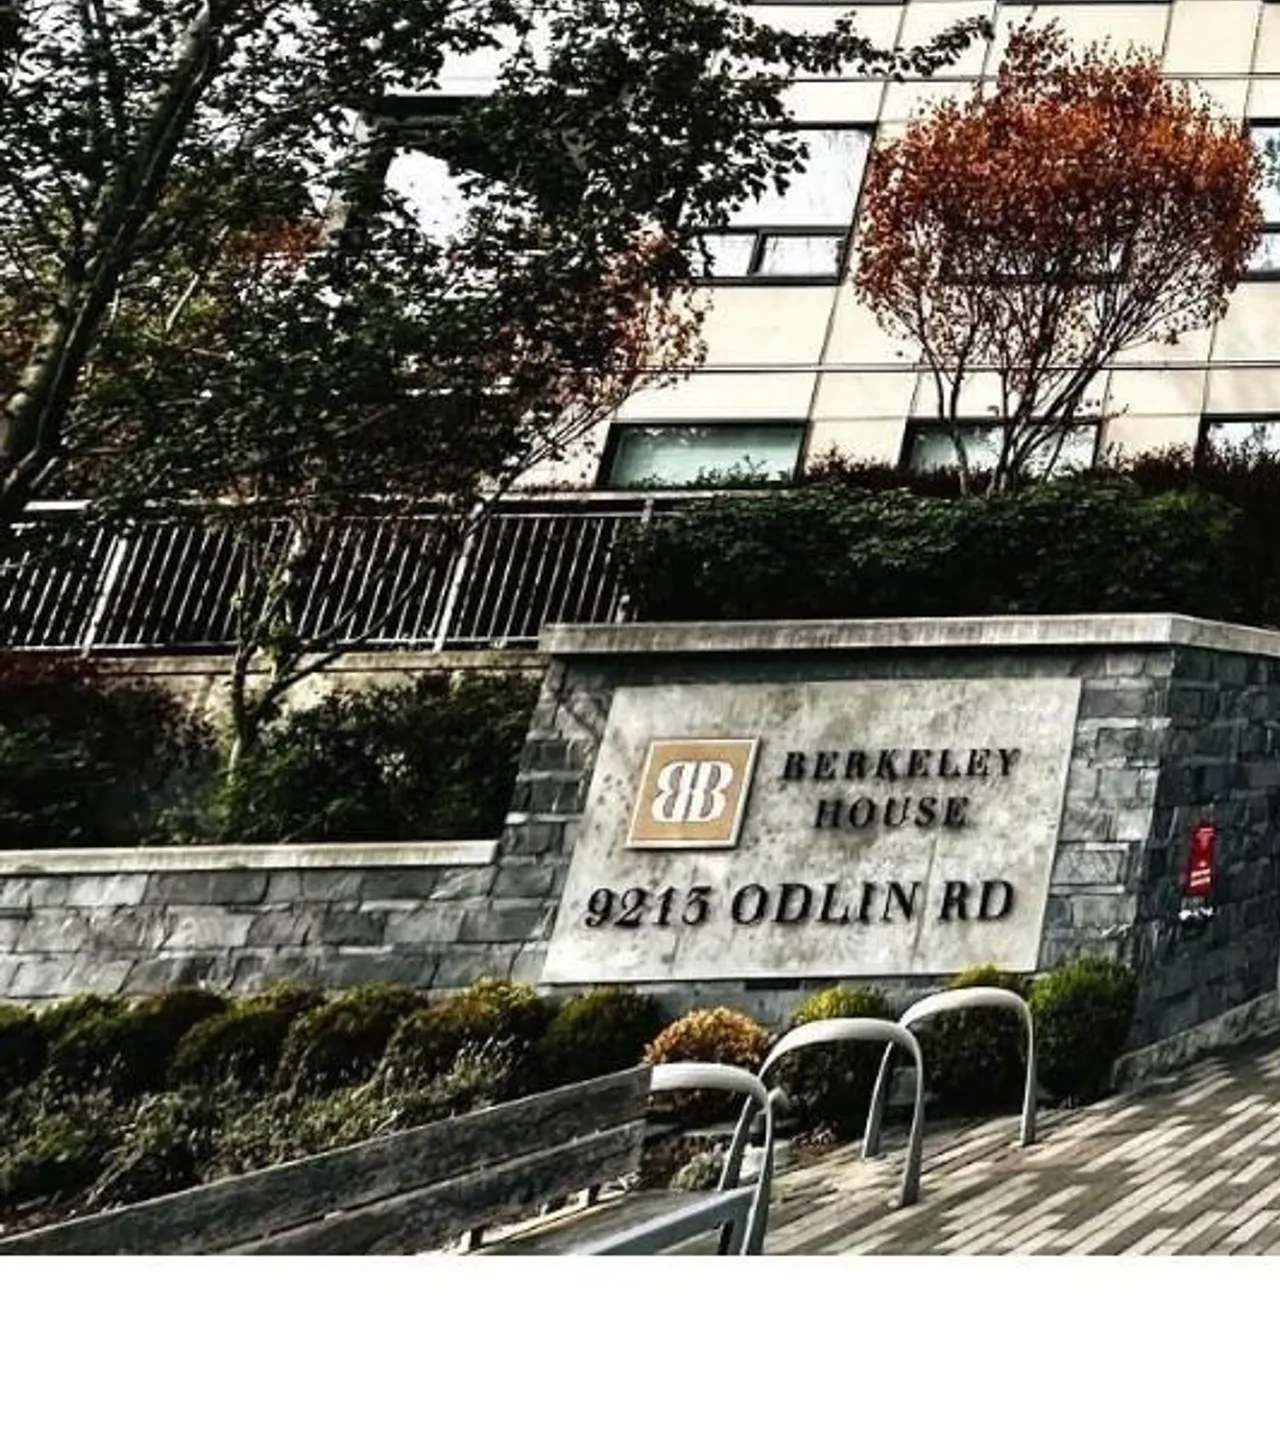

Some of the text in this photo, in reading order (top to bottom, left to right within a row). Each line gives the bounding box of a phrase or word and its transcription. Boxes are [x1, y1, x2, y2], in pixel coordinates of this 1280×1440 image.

[780, 747, 1021, 782] BERKELEY
[813, 795, 971, 832] HOUSE
[730, 879, 923, 927] ODLIN
[937, 878, 1016, 923] RD
